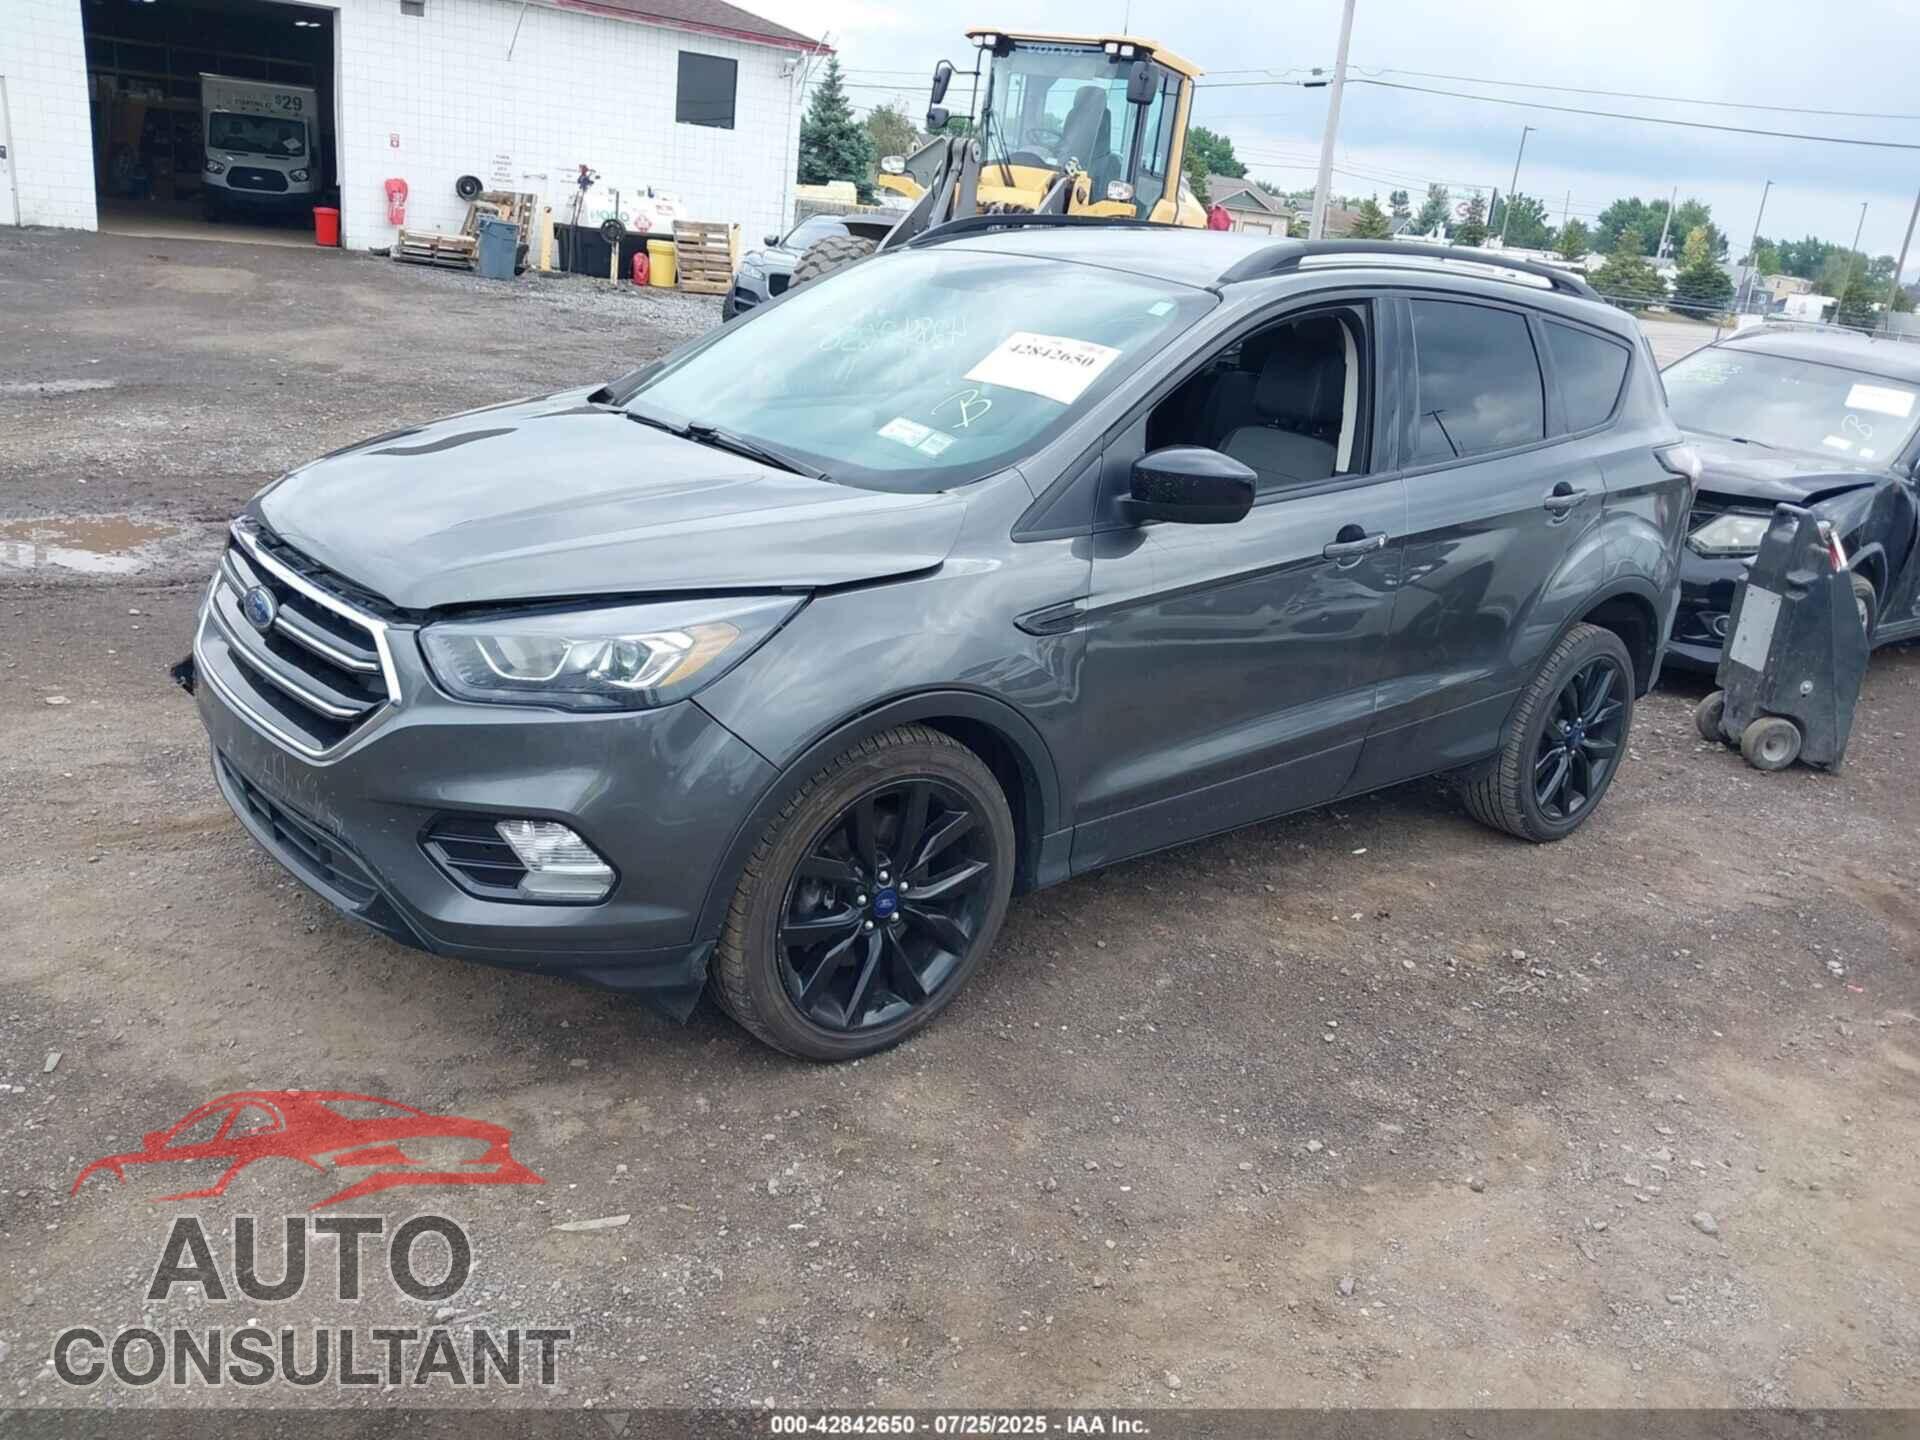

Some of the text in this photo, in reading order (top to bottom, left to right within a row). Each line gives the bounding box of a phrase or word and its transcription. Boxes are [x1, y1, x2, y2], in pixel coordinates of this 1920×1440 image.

[1023, 44, 1083, 57] VOLVO
[274, 95, 303, 111] $29
[1009, 343, 1096, 367] 42842650
